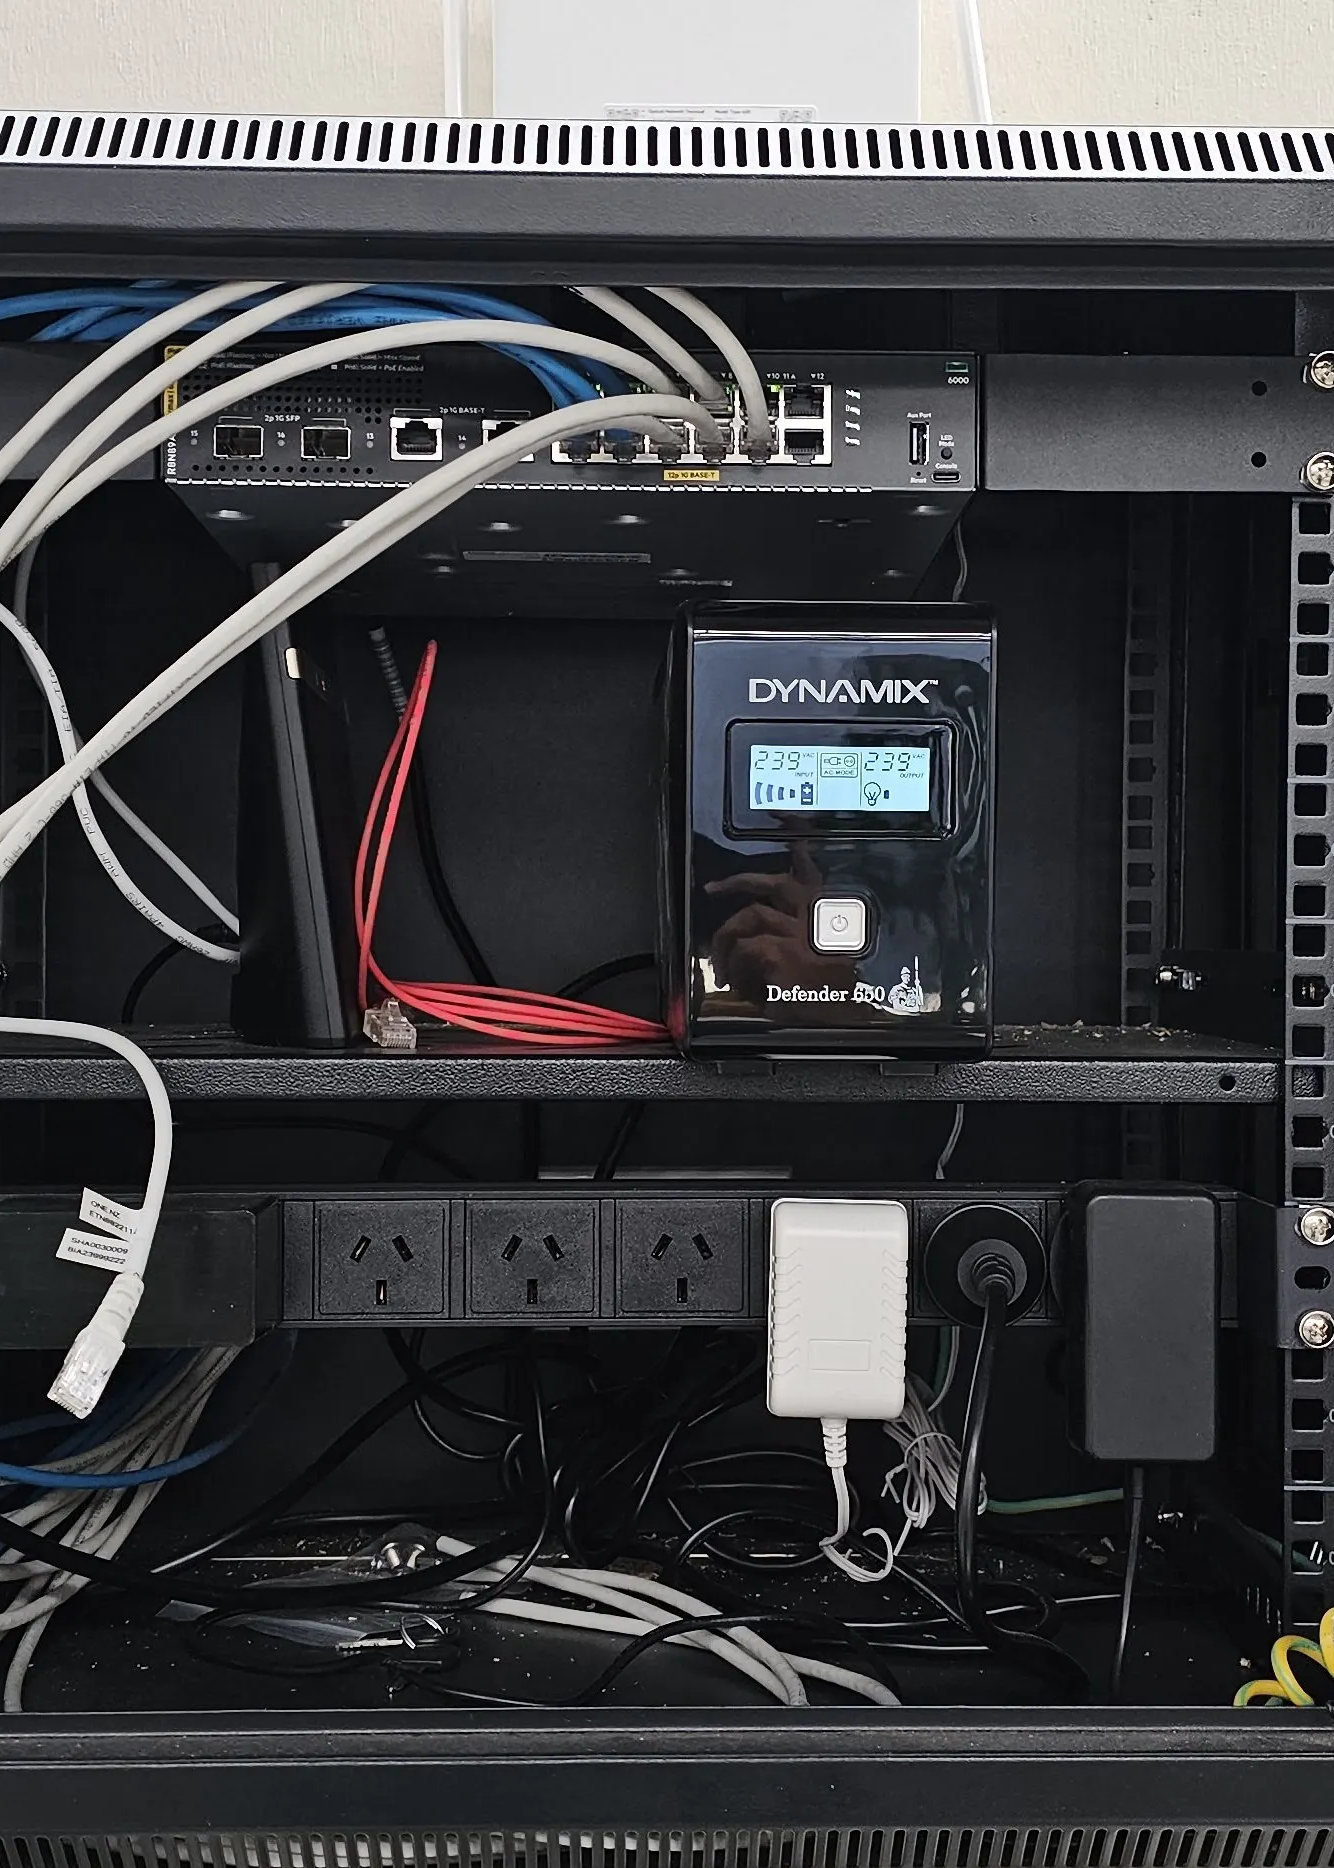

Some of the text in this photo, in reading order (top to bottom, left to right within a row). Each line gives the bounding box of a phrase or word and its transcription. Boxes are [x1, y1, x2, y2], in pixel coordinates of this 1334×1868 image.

[947, 376, 970, 385] 6000
[754, 750, 801, 771] 239
[864, 751, 911, 772] 239
[766, 984, 849, 1003] Defender
